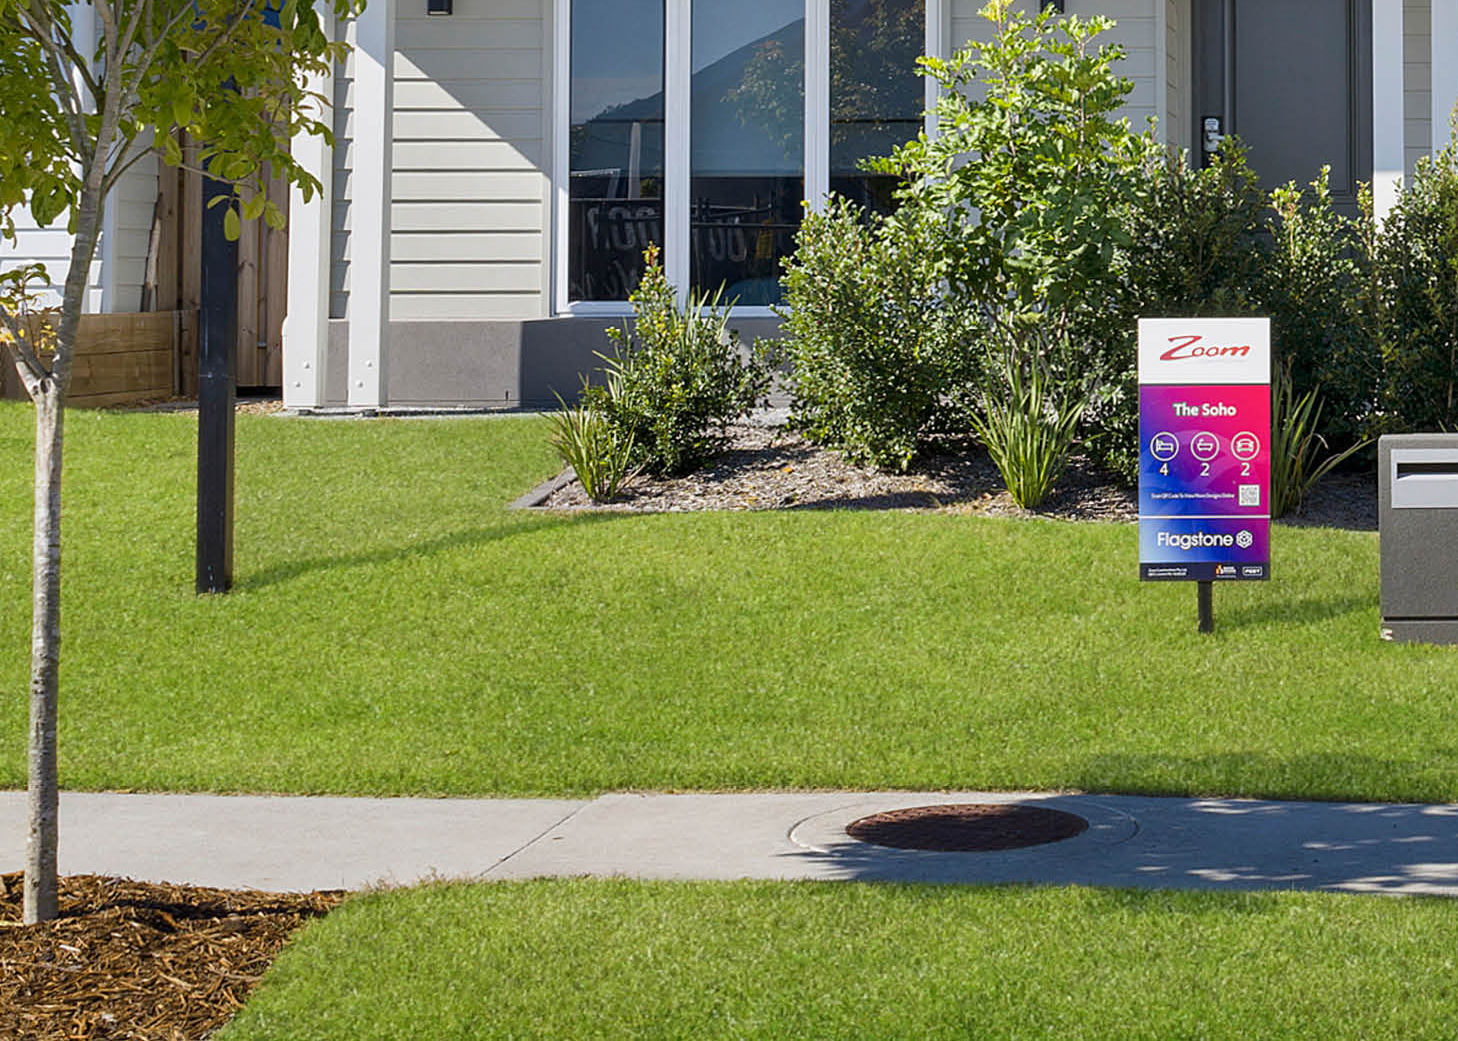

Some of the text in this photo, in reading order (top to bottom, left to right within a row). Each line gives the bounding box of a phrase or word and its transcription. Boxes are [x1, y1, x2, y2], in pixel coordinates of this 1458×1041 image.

[1159, 335, 1250, 361] Zoom
[1173, 402, 1237, 416] The Soho
[1159, 462, 1250, 476] 4 2 2
[1157, 531, 1234, 550] Flagstone
